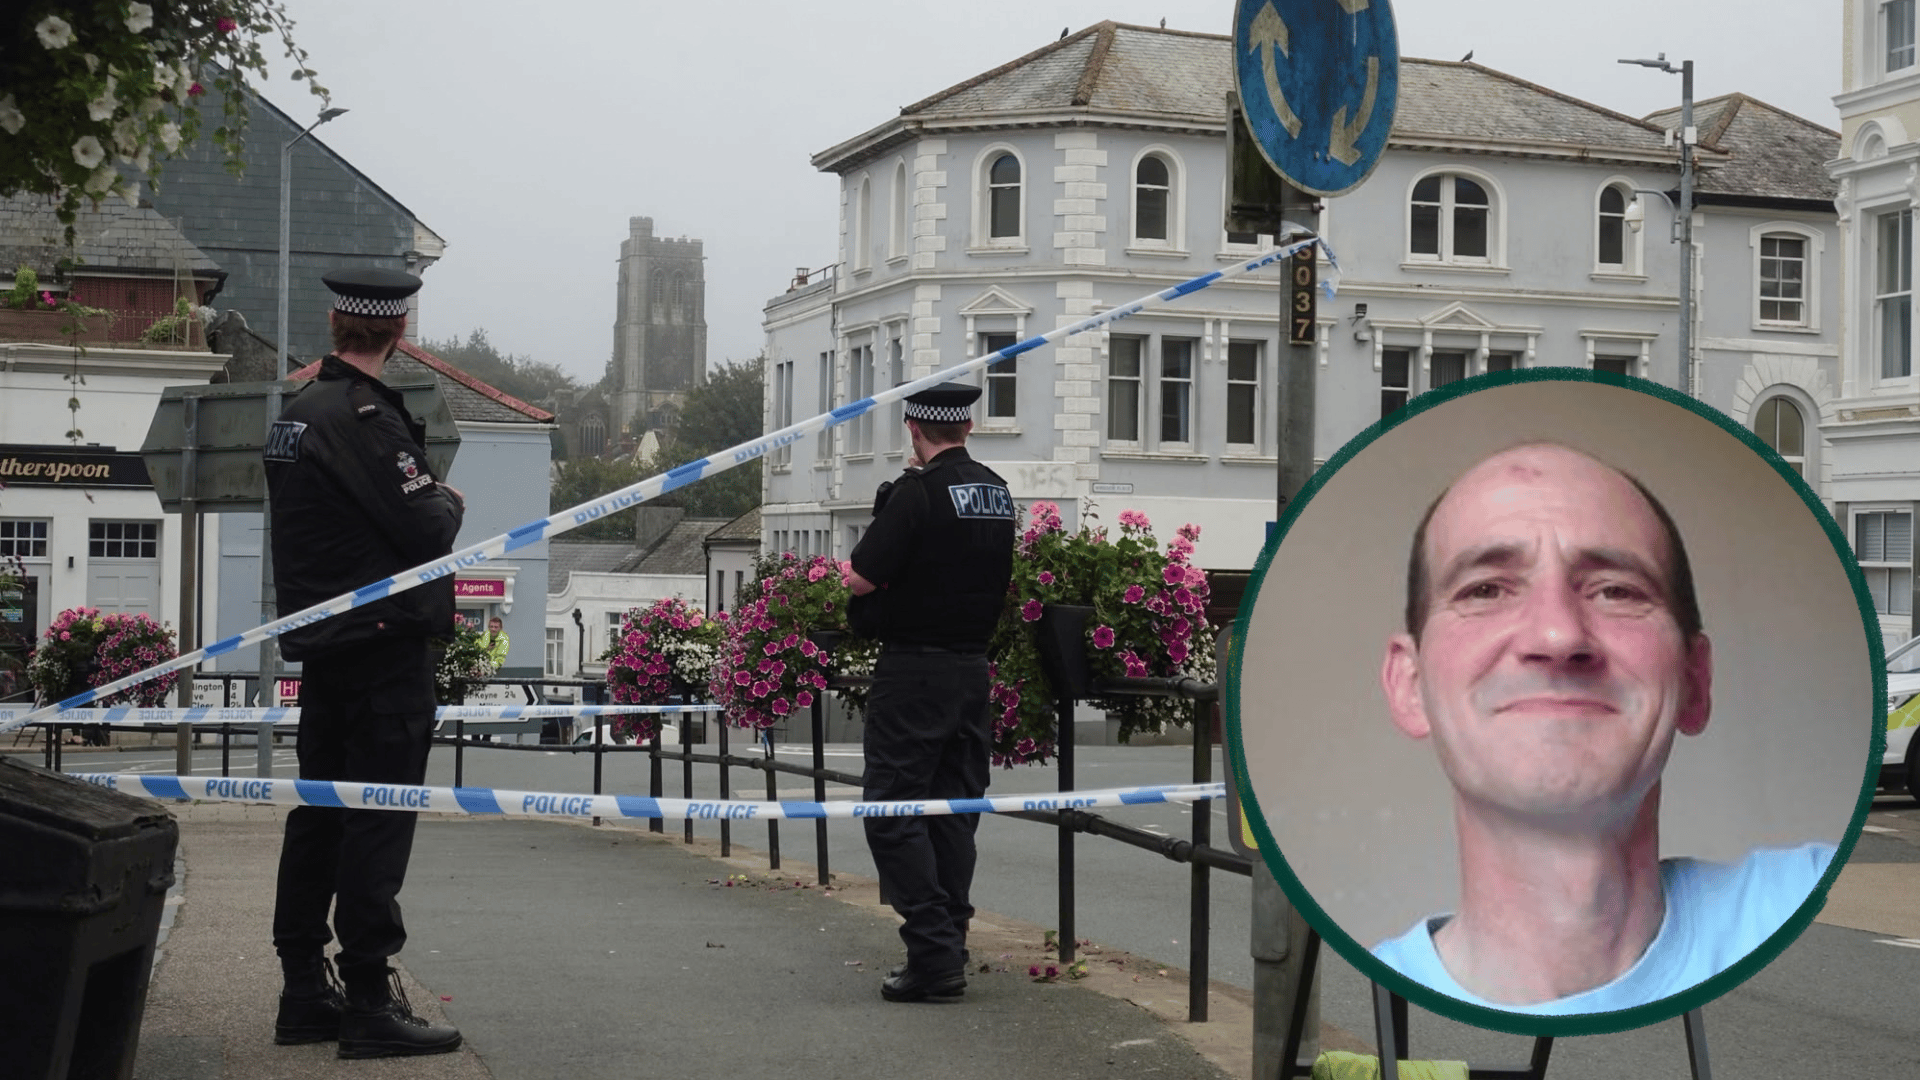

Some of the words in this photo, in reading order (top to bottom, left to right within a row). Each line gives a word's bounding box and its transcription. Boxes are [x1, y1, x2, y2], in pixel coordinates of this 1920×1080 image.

[0, 458, 110, 482] therspoon
[403, 476, 433, 494] POLICE
[956, 487, 1011, 515] POLICE
[462, 583, 494, 594] Agents
[192, 682, 223, 692] lington
[474, 690, 498, 700] Keyne
[206, 779, 274, 800] POLICE
[362, 786, 431, 808] POLICE
[523, 795, 593, 816] POLICE
[686, 803, 758, 820] POLICE
